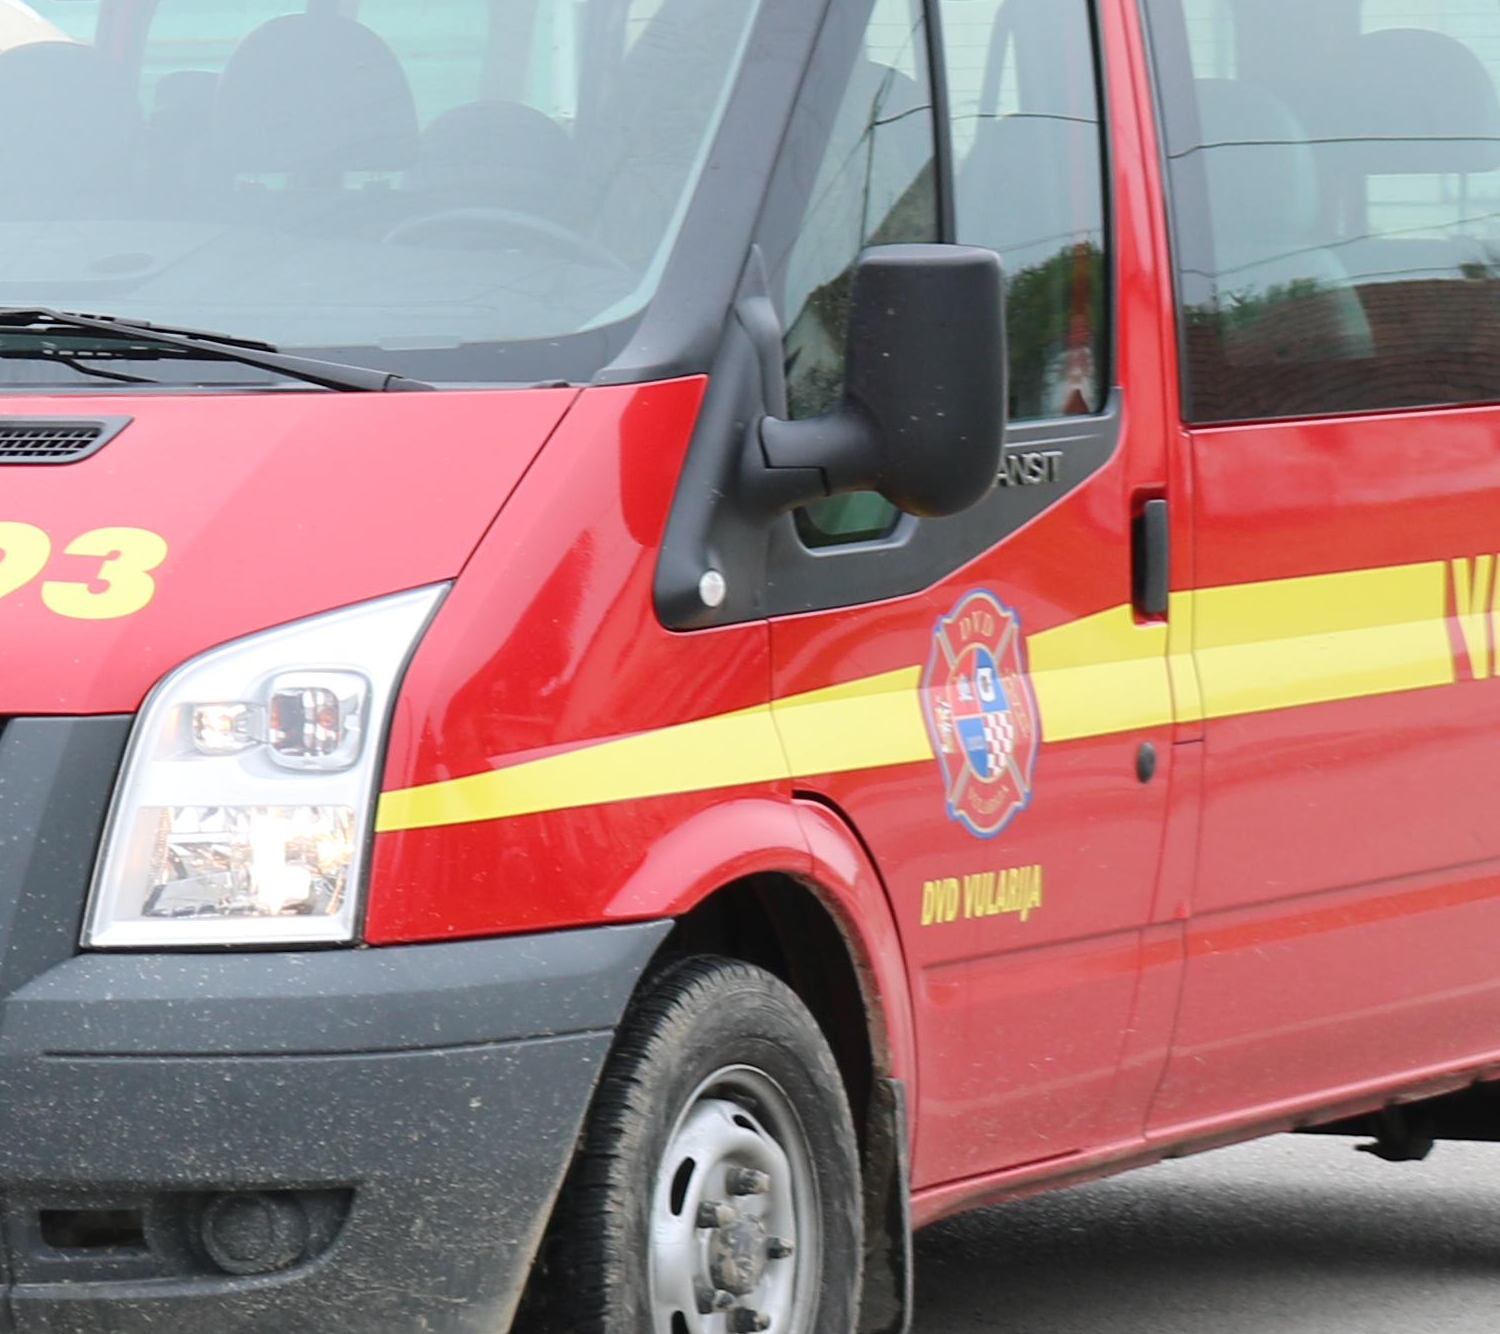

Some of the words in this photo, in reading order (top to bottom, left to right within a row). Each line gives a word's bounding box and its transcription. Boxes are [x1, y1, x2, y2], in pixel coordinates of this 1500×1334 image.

[1451, 553, 1500, 680] V
[921, 877, 960, 926] DVD
[963, 864, 1042, 922] VULARIJA
